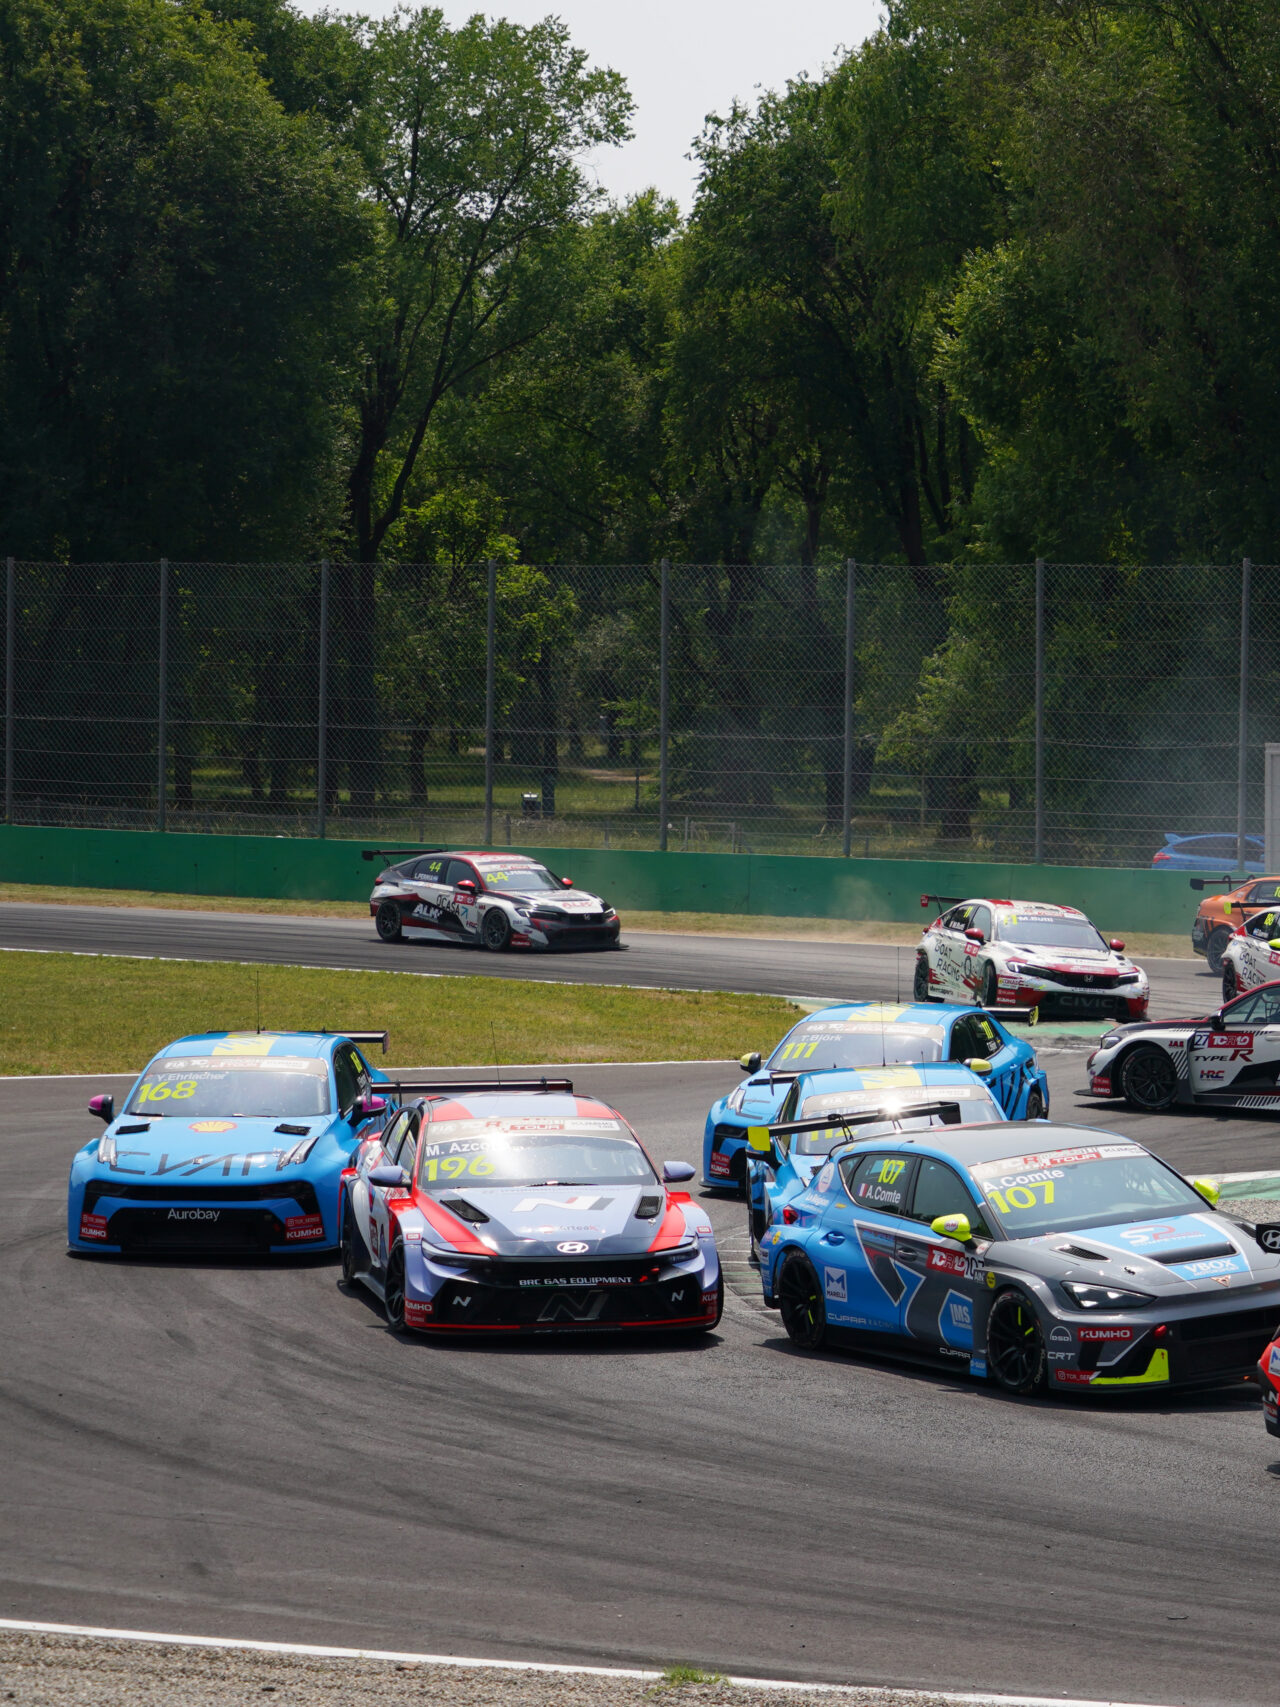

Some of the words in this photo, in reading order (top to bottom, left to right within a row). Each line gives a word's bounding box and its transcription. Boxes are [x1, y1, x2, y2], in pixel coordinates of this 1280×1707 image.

[429, 861, 442, 872] 44
[486, 871, 509, 883] 44
[781, 1041, 818, 1060] 111
[1229, 1048, 1254, 1062] R
[157, 1071, 226, 1082] Y.Ehrlacher
[138, 1080, 198, 1104] 168
[425, 1144, 446, 1158] M.
[424, 1155, 496, 1182] 196
[878, 1158, 905, 1185] 107
[983, 1168, 1065, 1194] A.Comte
[865, 1185, 901, 1204] A.Comte
[987, 1179, 1055, 1214] 107
[167, 1207, 221, 1222] Aurobay
[80, 1227, 107, 1238] KUMHO
[286, 1227, 323, 1239] KUMHO
[1183, 1258, 1234, 1274] VBOX
[519, 1278, 541, 1286] BRC
[544, 1277, 567, 1285] GAS
[570, 1276, 632, 1285] EQUIPMENT
[826, 1290, 847, 1300] MARELLI
[405, 1301, 432, 1312] UMHO
[827, 1312, 867, 1326] CUPRA
[1080, 1329, 1131, 1339] KUMHO
[1047, 1351, 1076, 1361] CRT
